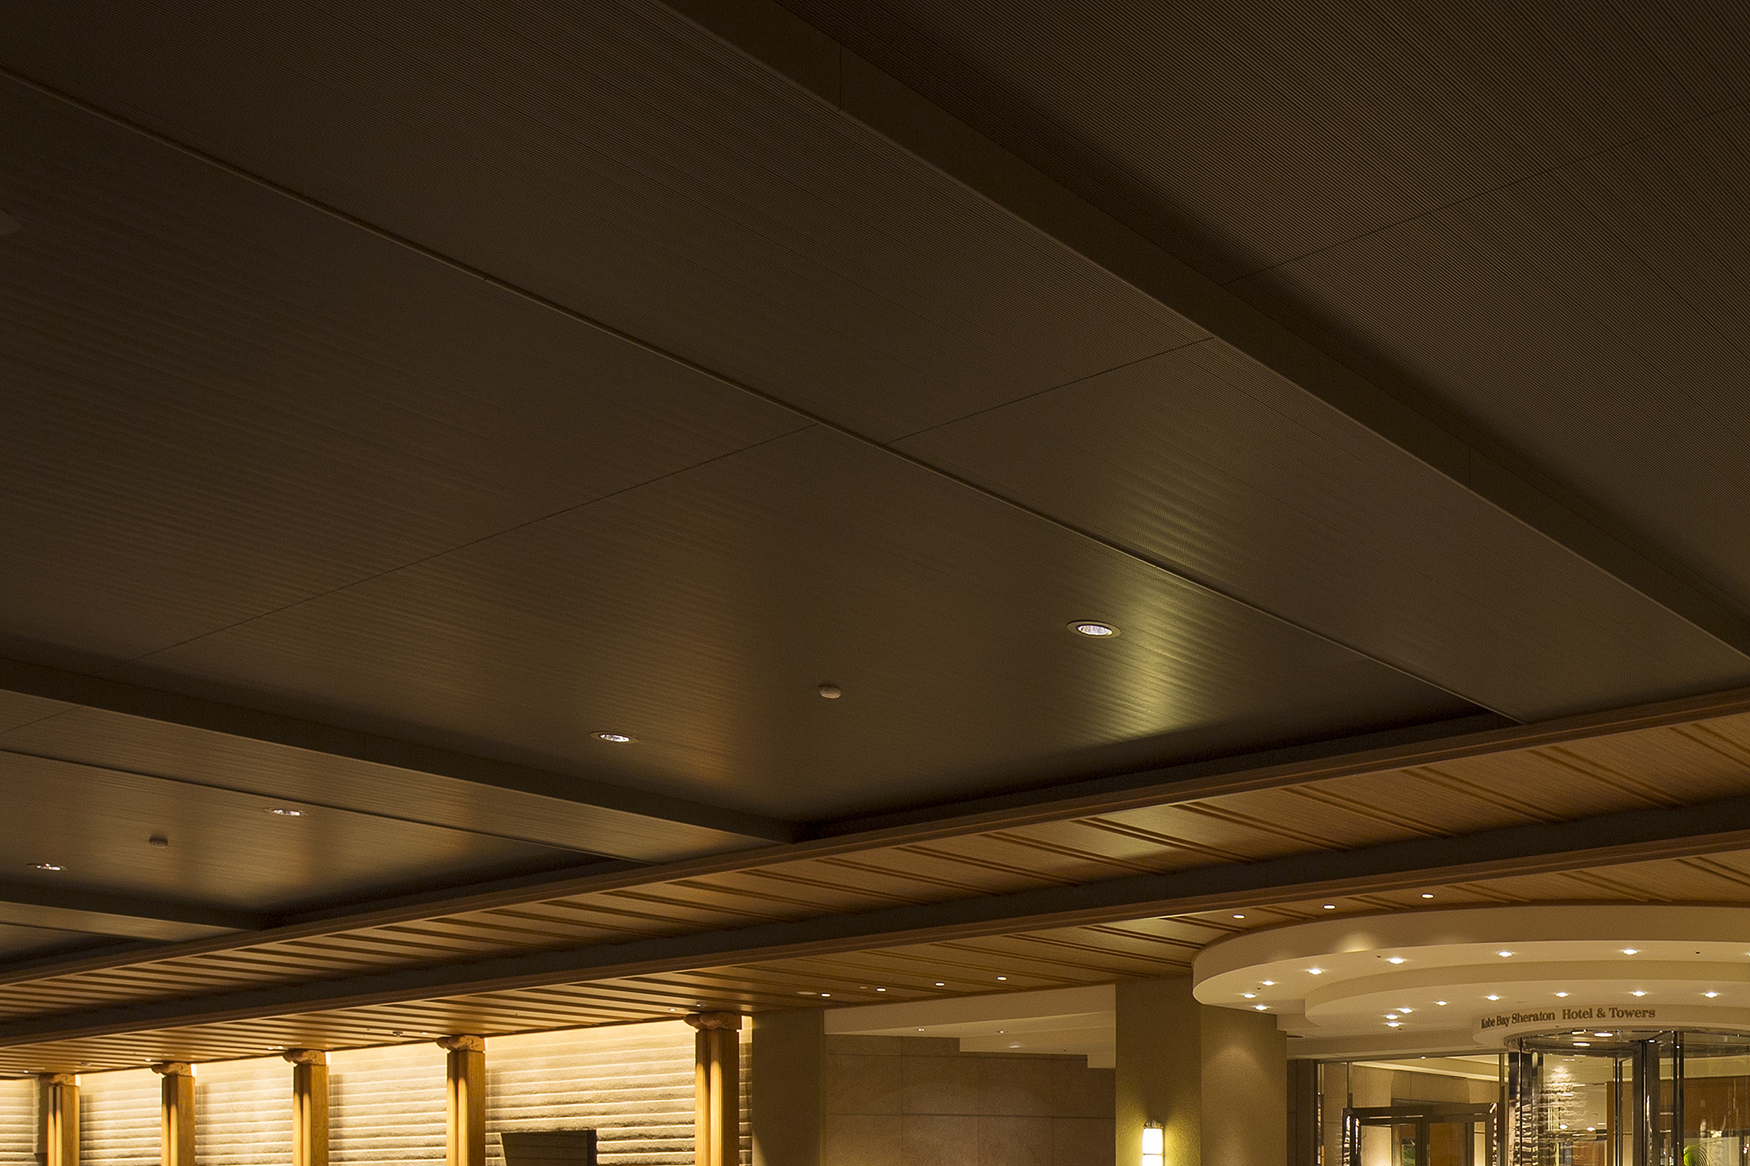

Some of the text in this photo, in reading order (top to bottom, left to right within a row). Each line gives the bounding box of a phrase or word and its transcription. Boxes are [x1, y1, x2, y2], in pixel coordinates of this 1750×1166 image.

[1481, 1007, 1656, 1029] Kobe Bay Sheraton Hotel & Towers
